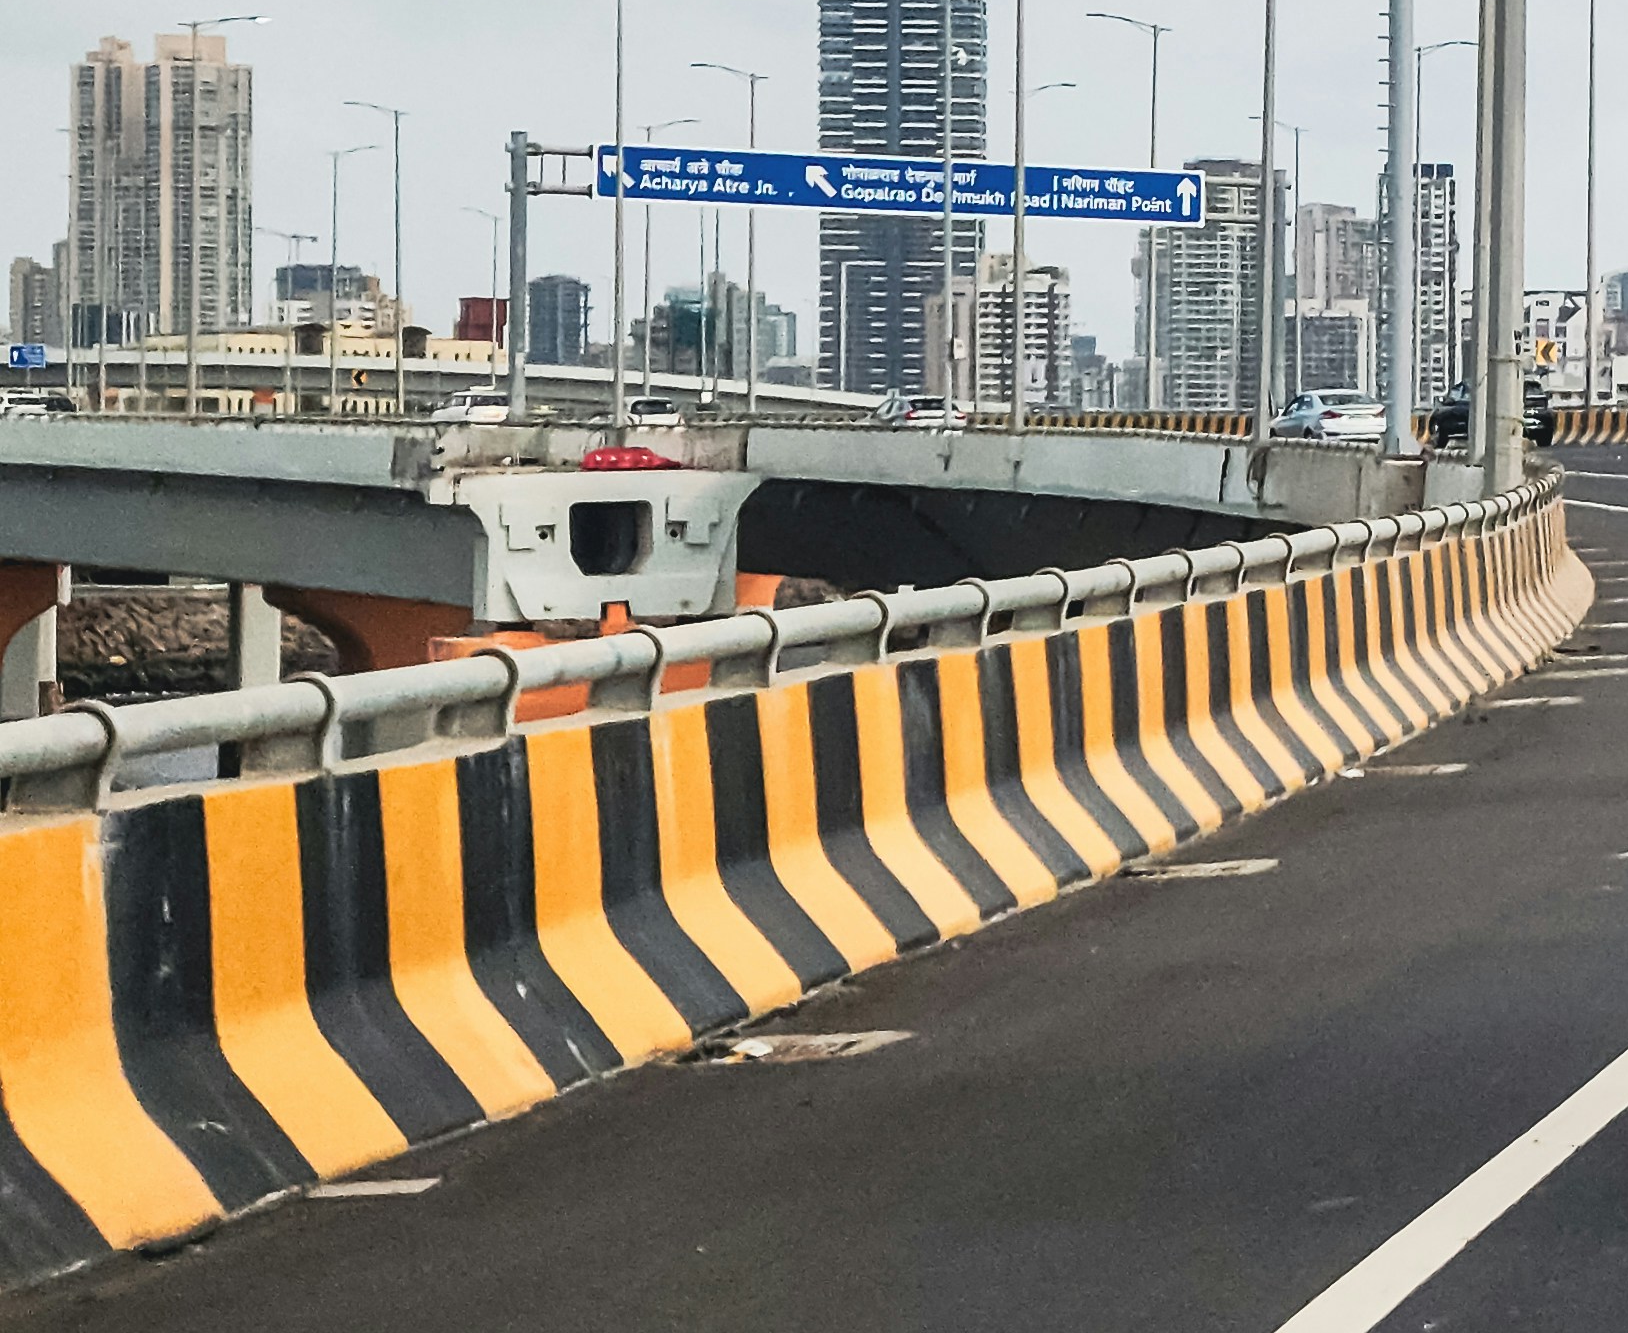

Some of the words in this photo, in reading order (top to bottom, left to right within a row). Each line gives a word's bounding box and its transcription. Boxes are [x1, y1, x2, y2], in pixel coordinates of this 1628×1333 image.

[639, 174, 708, 196] Acharya
[712, 177, 750, 194] Atre
[840, 184, 917, 202] Gopalrao
[921, 187, 1006, 207] Dehmukh
[1061, 194, 1127, 211] Nariman
[1131, 196, 1173, 213] Point
